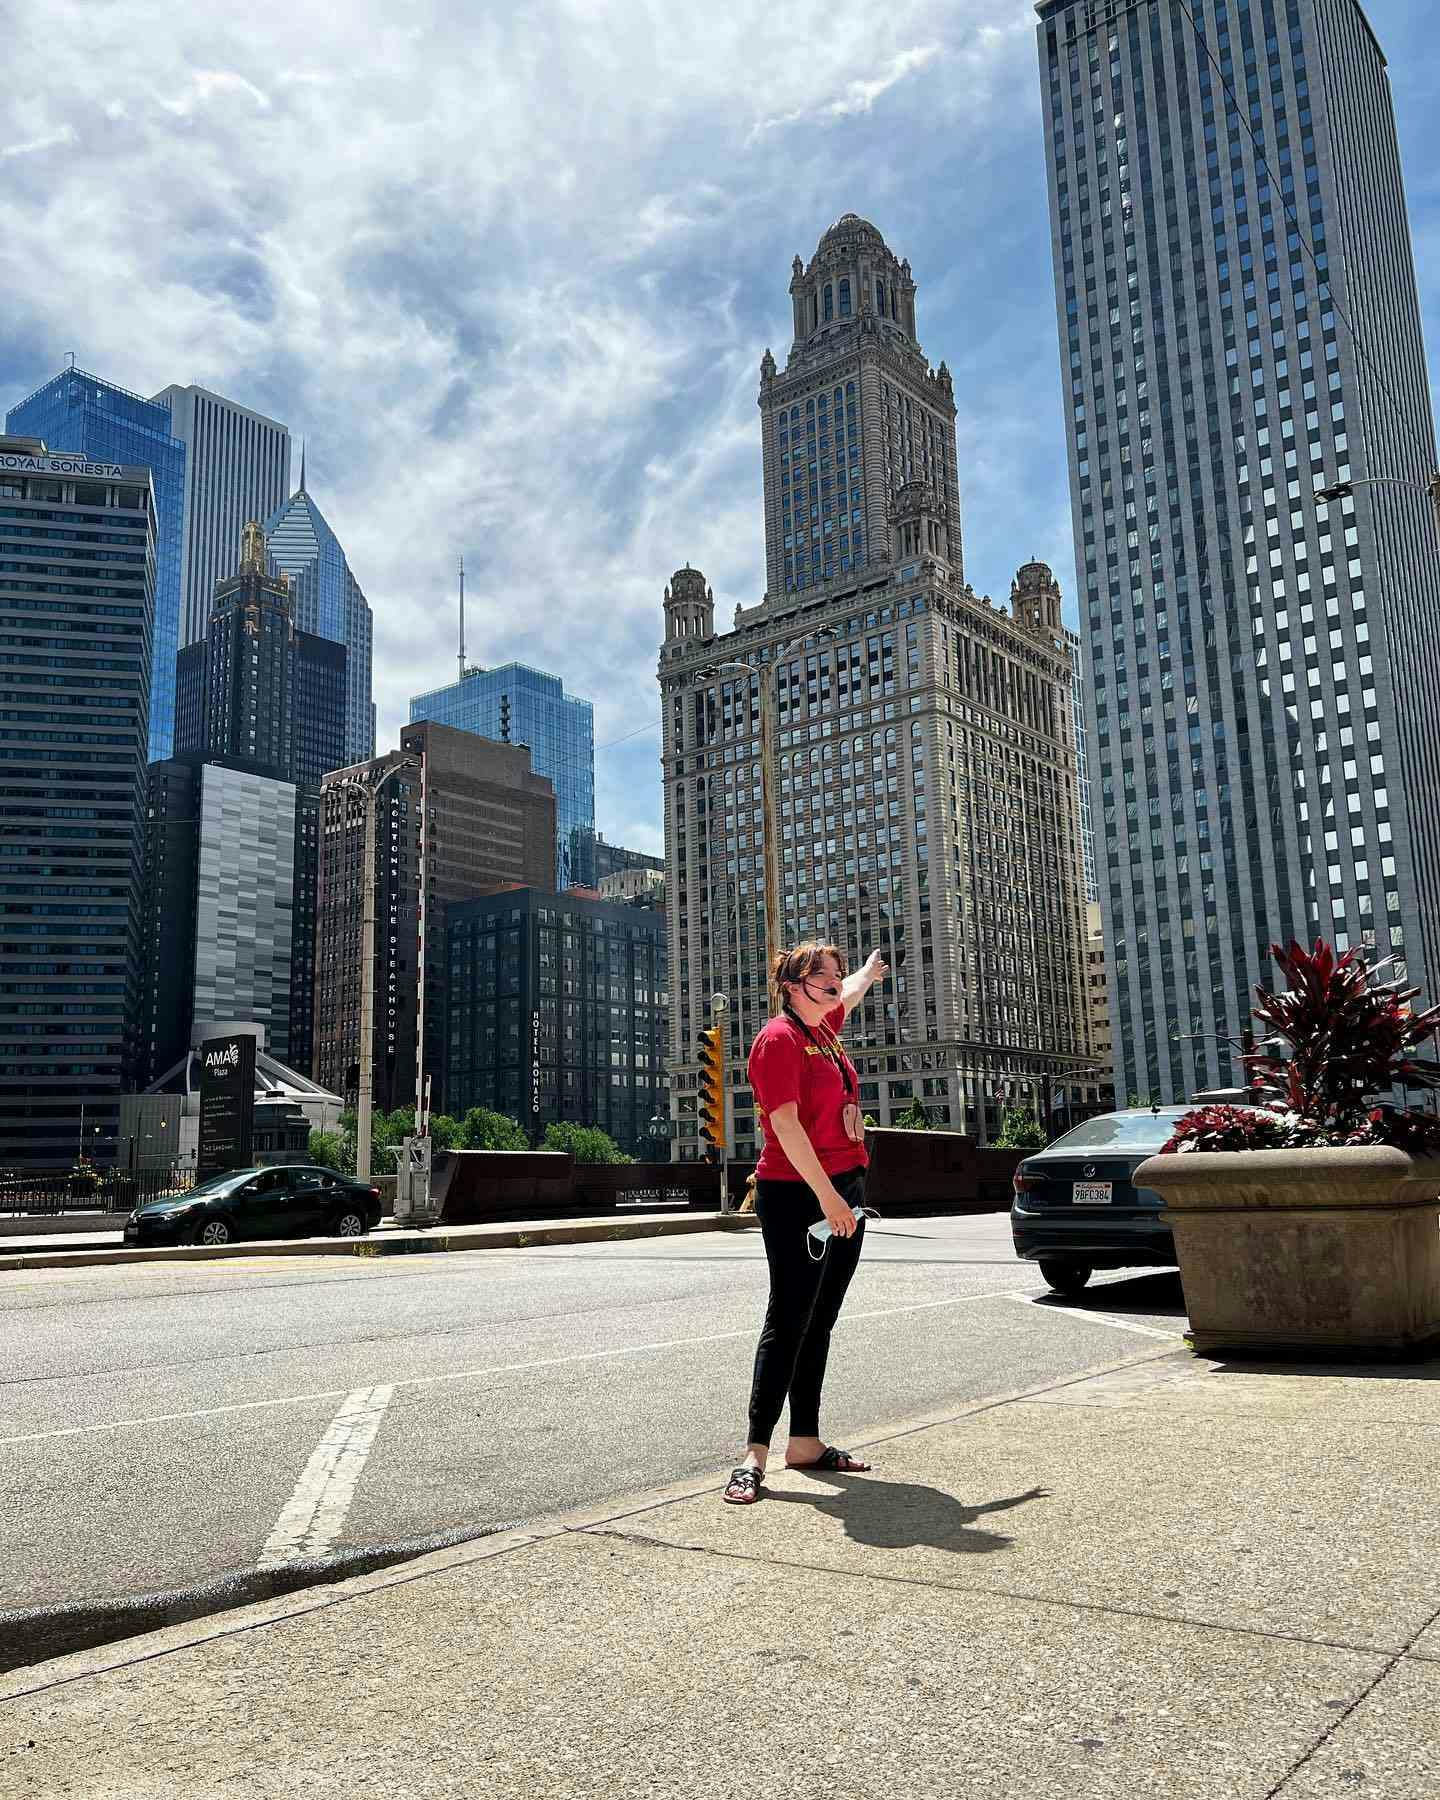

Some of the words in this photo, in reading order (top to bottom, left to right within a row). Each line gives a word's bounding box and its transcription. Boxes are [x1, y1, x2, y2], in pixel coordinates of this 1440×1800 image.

[50, 460, 123, 477] SONESTA
[390, 797, 399, 876] MORTONS
[389, 893, 398, 924] THE
[387, 935, 397, 1054] STEAKHOUSE
[532, 1011, 540, 1054] HOTEL
[205, 1050, 231, 1067] AMA
[532, 1060, 540, 1113] MONACO
